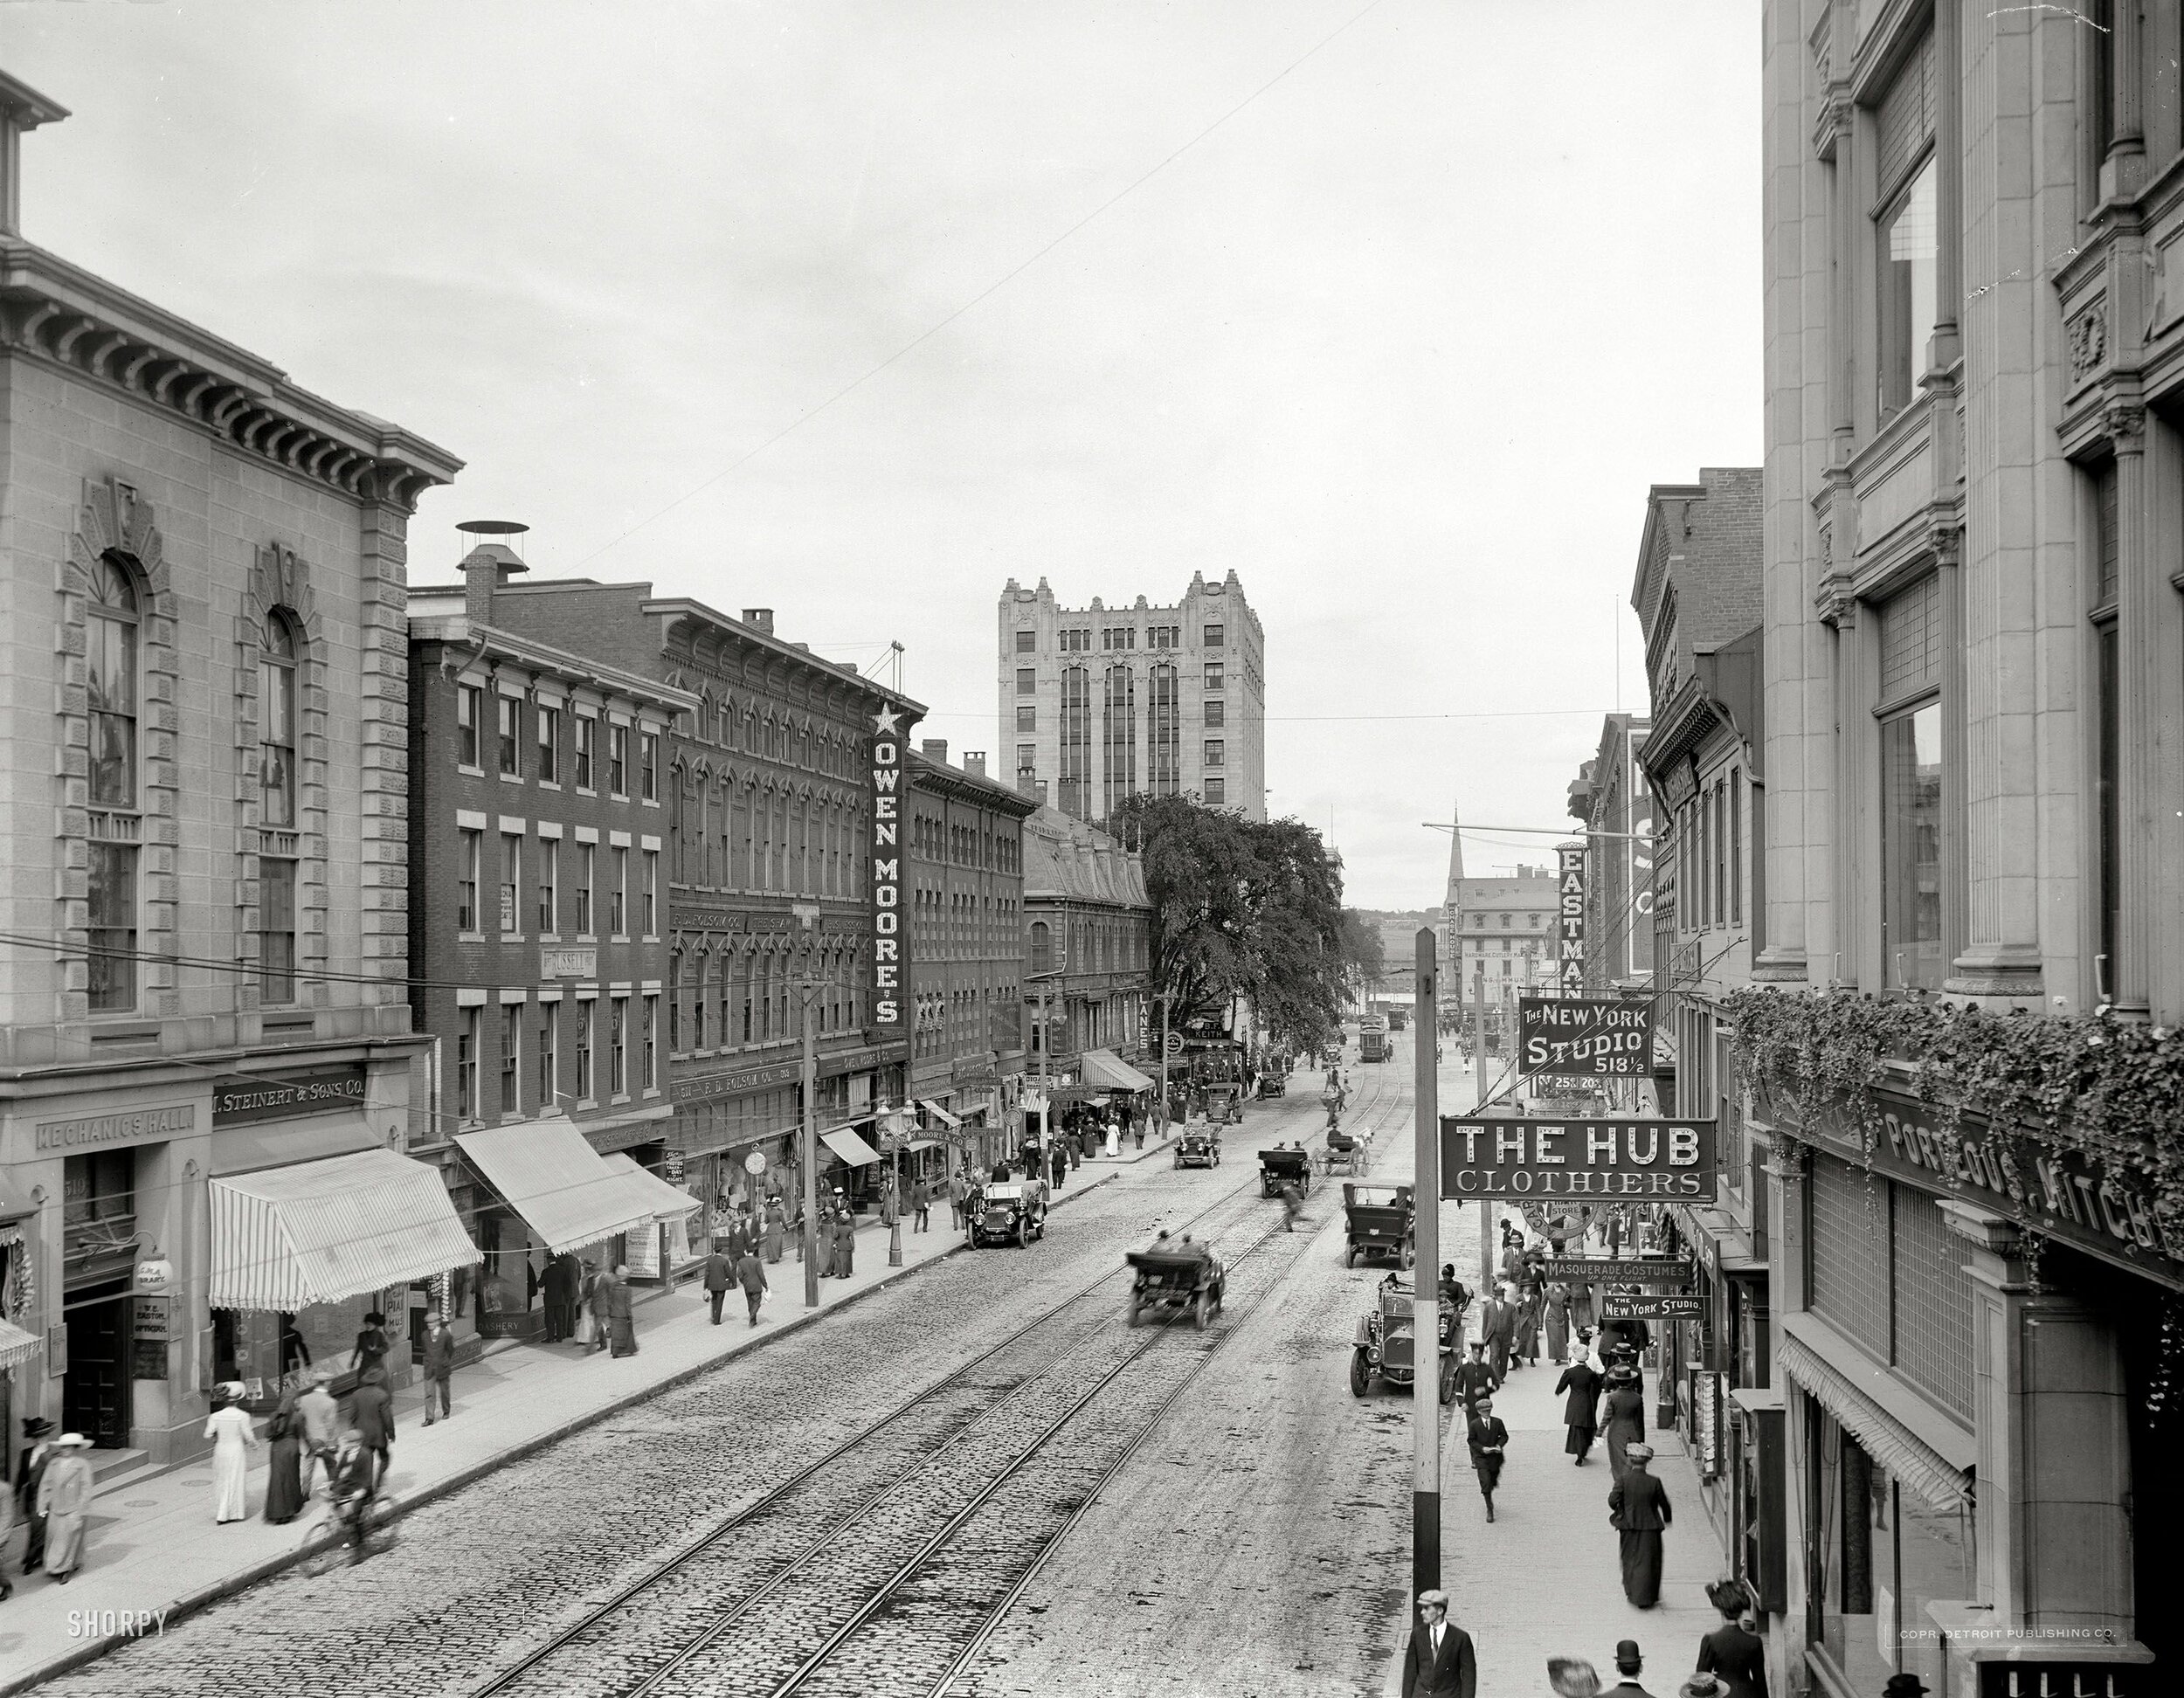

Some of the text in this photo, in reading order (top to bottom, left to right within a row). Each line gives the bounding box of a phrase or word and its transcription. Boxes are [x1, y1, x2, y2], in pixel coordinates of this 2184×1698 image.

[874, 742, 899, 846] OWEN
[875, 859, 898, 1023] MOORE'S
[552, 953, 584, 970] RUSSELL
[1139, 993, 1148, 1049] LANES
[1524, 1004, 1648, 1028] THE NEW YORK
[1528, 1032, 1641, 1064] STUDIO
[224, 1088, 294, 1112] STEINERT
[297, 1086, 307, 1102] &
[309, 1082, 342, 1101] SONS
[346, 1079, 364, 1095] CO.
[726, 1074, 757, 1092] FOLSOM
[917, 1130, 944, 1141] MOORE
[945, 1134, 951, 1142] &
[1456, 1126, 1699, 1166] THE HUB
[1456, 1170, 1701, 1196] CLOTHIERS
[1549, 1262, 1689, 1277] MASQUERADE COSTUMES.
[1606, 1299, 1702, 1316] NEW YORK STUDIO.
